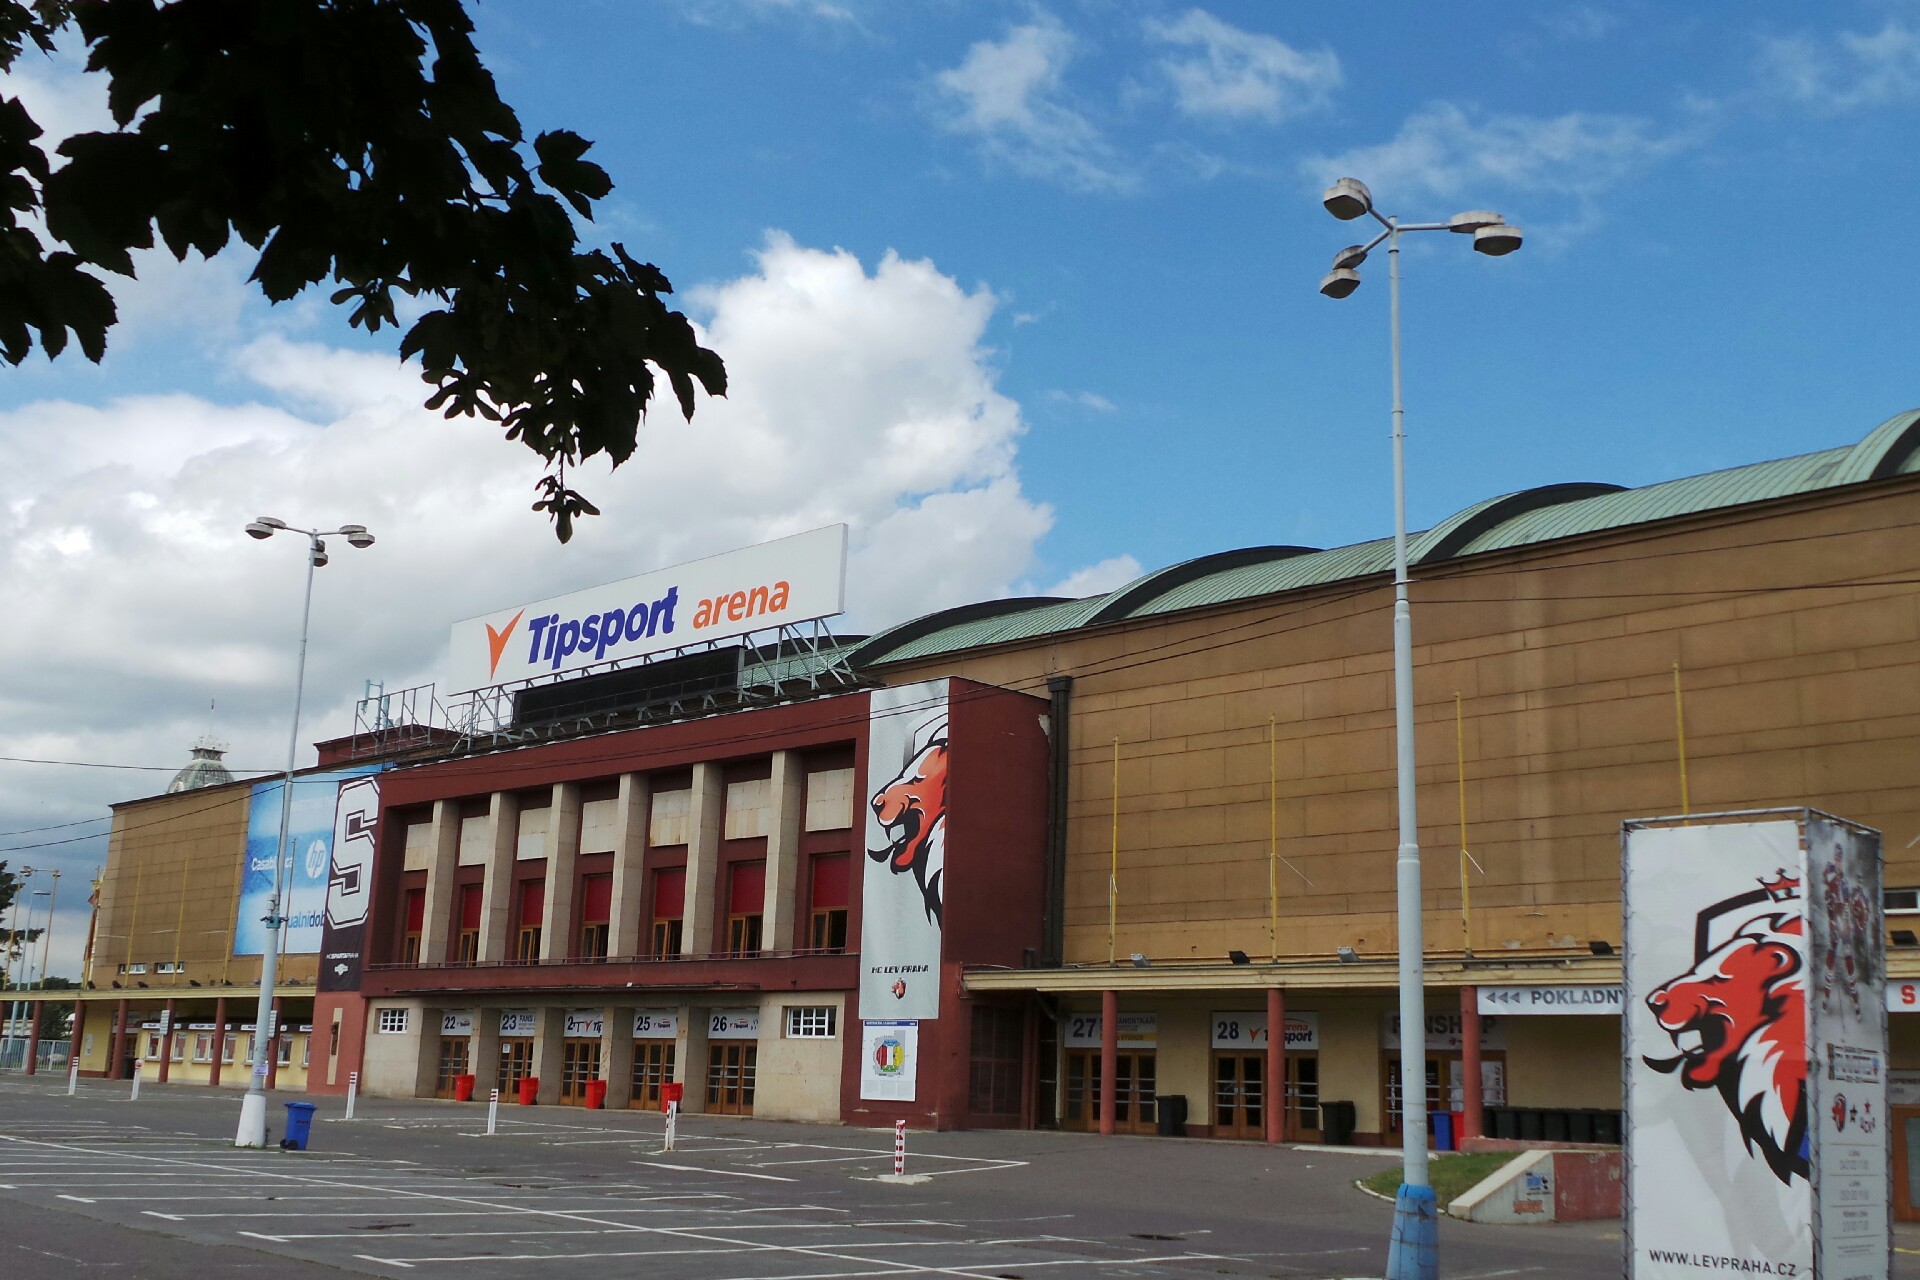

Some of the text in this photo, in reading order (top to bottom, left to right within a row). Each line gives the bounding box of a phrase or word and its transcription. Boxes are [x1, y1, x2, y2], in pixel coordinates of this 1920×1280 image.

[527, 580, 790, 670] Tipsport arena
[901, 964, 929, 973] PRAHA
[1530, 989, 1624, 1005] POKLADN
[1901, 984, 1917, 1005] S
[444, 1016, 456, 1030] 22
[501, 1014, 517, 1030] 23
[636, 1016, 651, 1031] 25
[712, 1016, 728, 1032] 26
[1072, 1018, 1097, 1038] 27
[1391, 1015, 1497, 1034] FNSHP
[1217, 1021, 1240, 1040] 28
[1263, 1030, 1313, 1045] Tsport
[1648, 1249, 1797, 1277] WWW.LEVPRAHA.CZ
